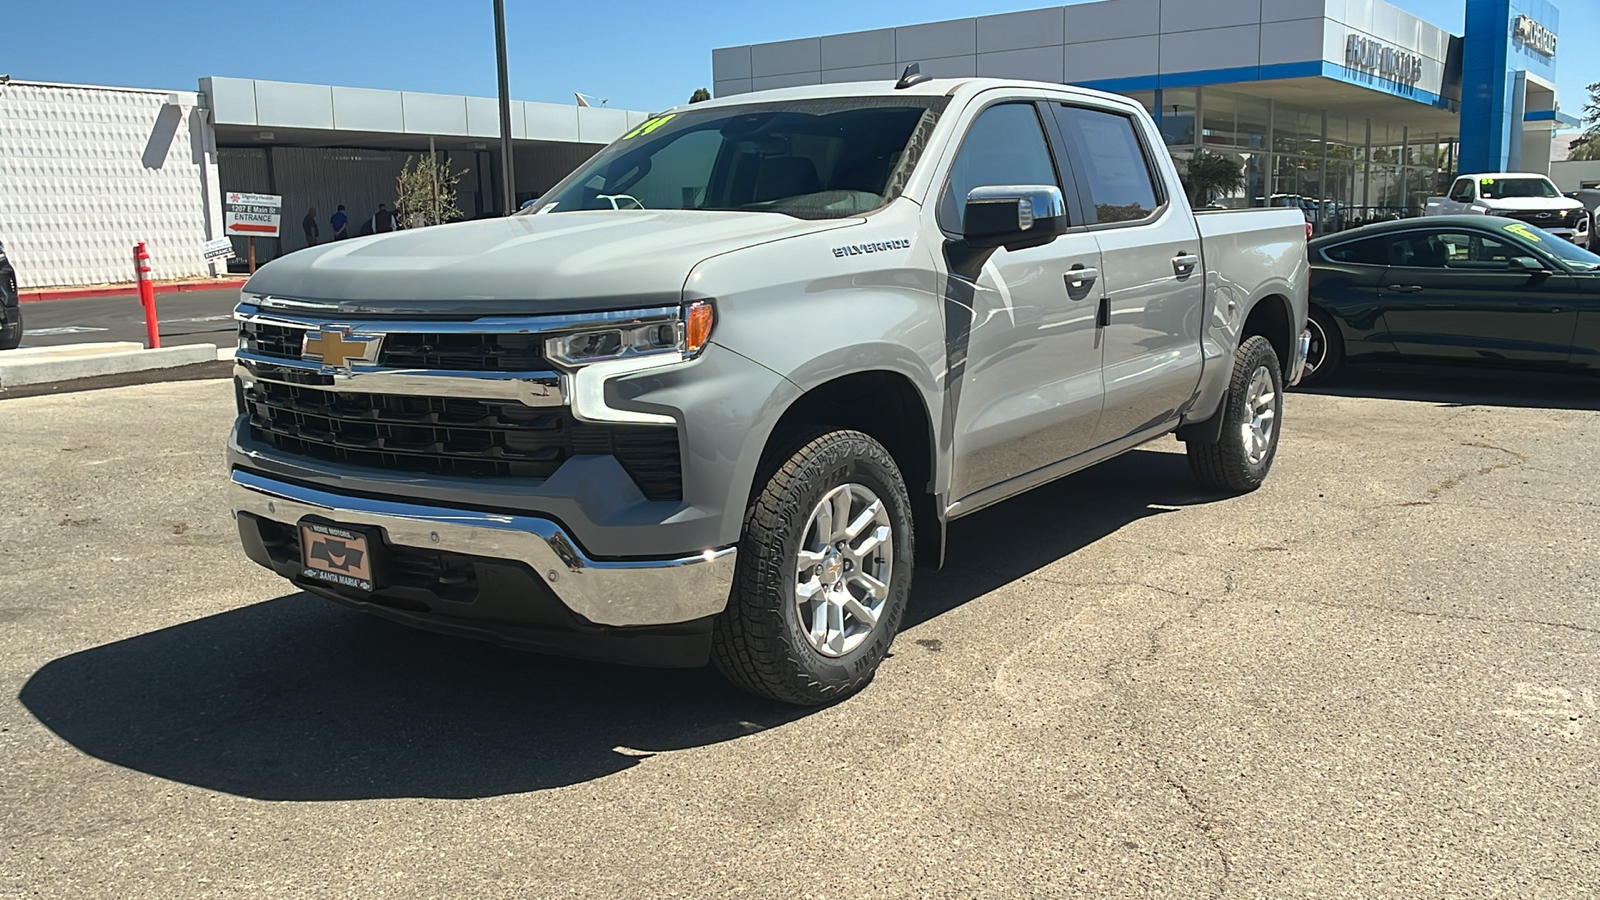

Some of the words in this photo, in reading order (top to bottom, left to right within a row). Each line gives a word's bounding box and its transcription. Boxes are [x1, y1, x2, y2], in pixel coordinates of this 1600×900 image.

[1345, 34, 1382, 71] HOME
[1380, 46, 1422, 82] MOTORS
[231, 204, 247, 212] 1207
[247, 205, 252, 213] E
[234, 213, 272, 222] ENTRANCE
[832, 239, 911, 258] SILVERADO
[313, 525, 329, 534] HOME
[328, 528, 351, 538] MOTORS
[320, 571, 339, 583] SANTA
[339, 575, 358, 587] MARIA
